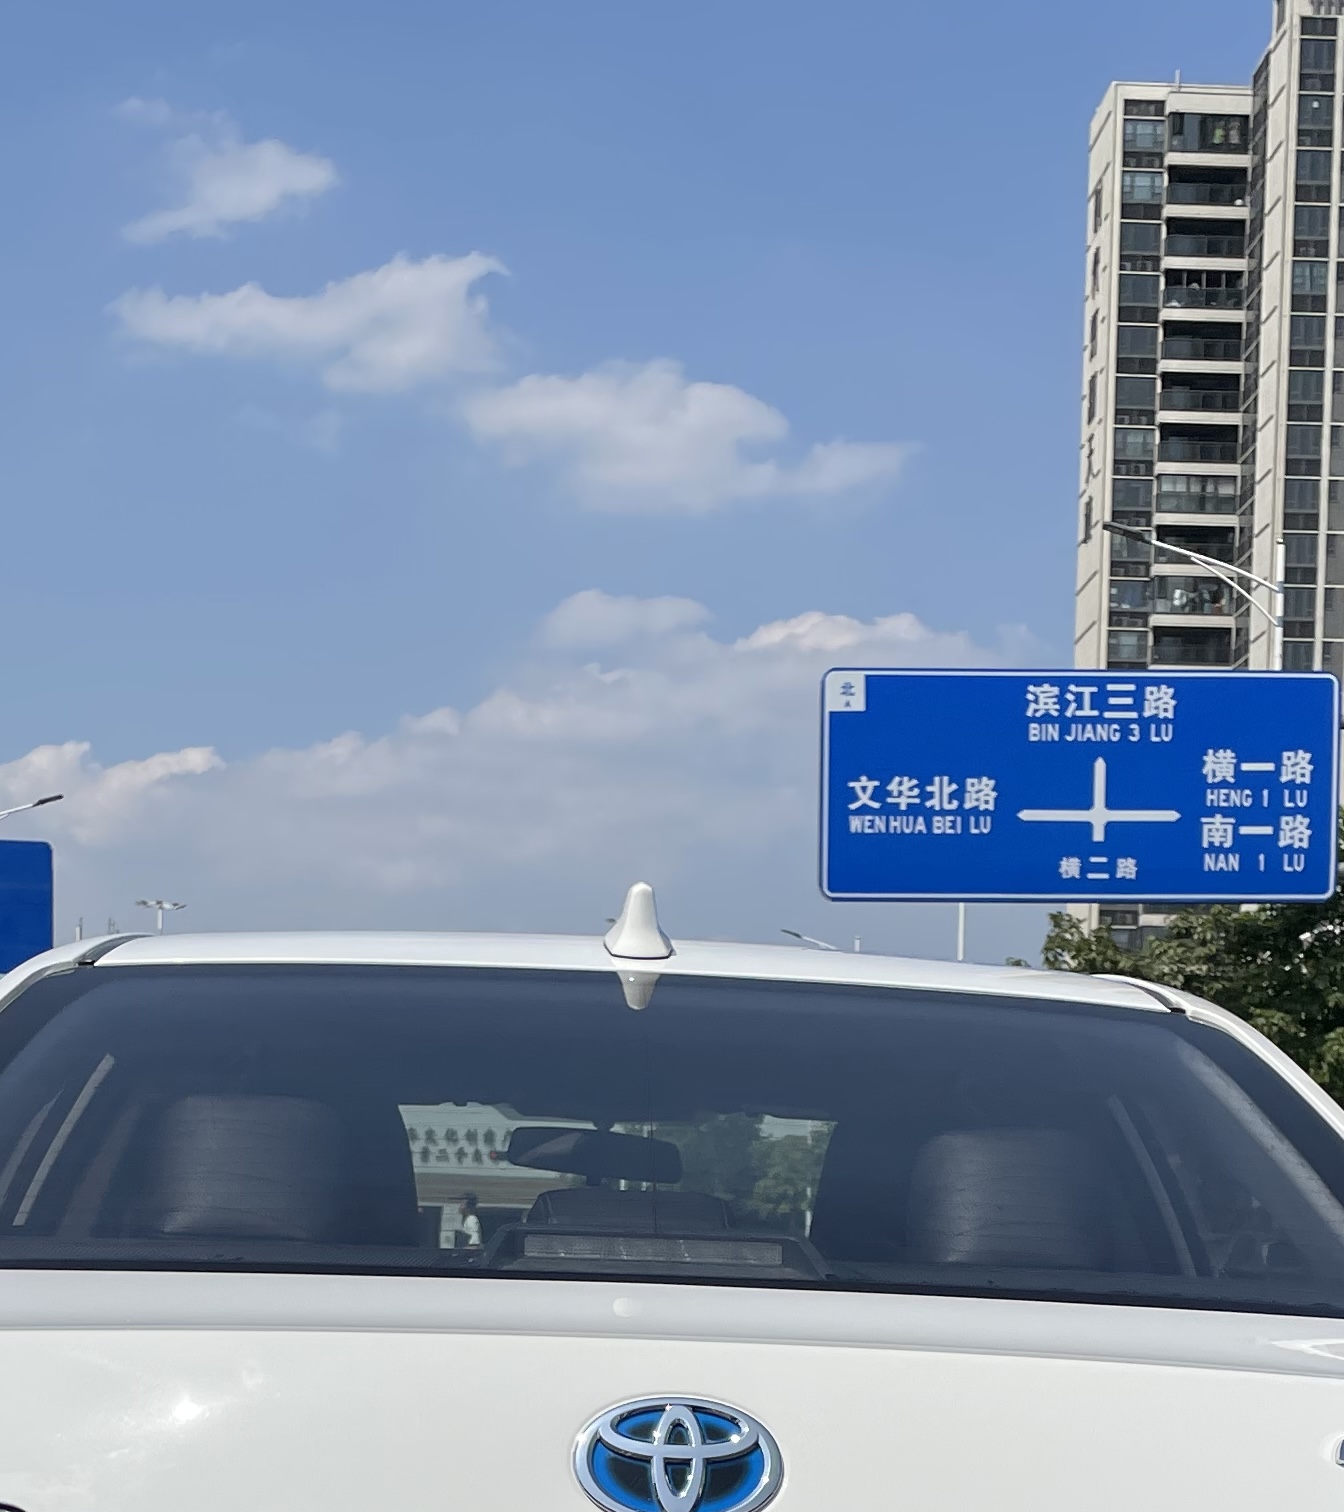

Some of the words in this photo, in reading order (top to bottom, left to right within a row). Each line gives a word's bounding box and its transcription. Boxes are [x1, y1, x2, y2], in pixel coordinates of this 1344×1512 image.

[1025, 683, 1177, 719] 滨江三路
[1028, 723, 1060, 742] BIN
[1065, 723, 1121, 742] JIANG
[1128, 724, 1141, 742] 3
[1150, 724, 1173, 742] LU
[1202, 748, 1314, 784] 横一路
[847, 775, 998, 811] 文华北路
[1206, 788, 1253, 807] HENG
[1261, 789, 1269, 807] 1
[1284, 789, 1308, 808] LU
[932, 815, 962, 834] BEI
[969, 815, 992, 834] LU
[1200, 813, 1313, 849] 南一路
[1059, 856, 1138, 880] 横二路
[1203, 853, 1240, 872] NAN
[1258, 853, 1265, 871] 1
[1283, 854, 1306, 872] LU
